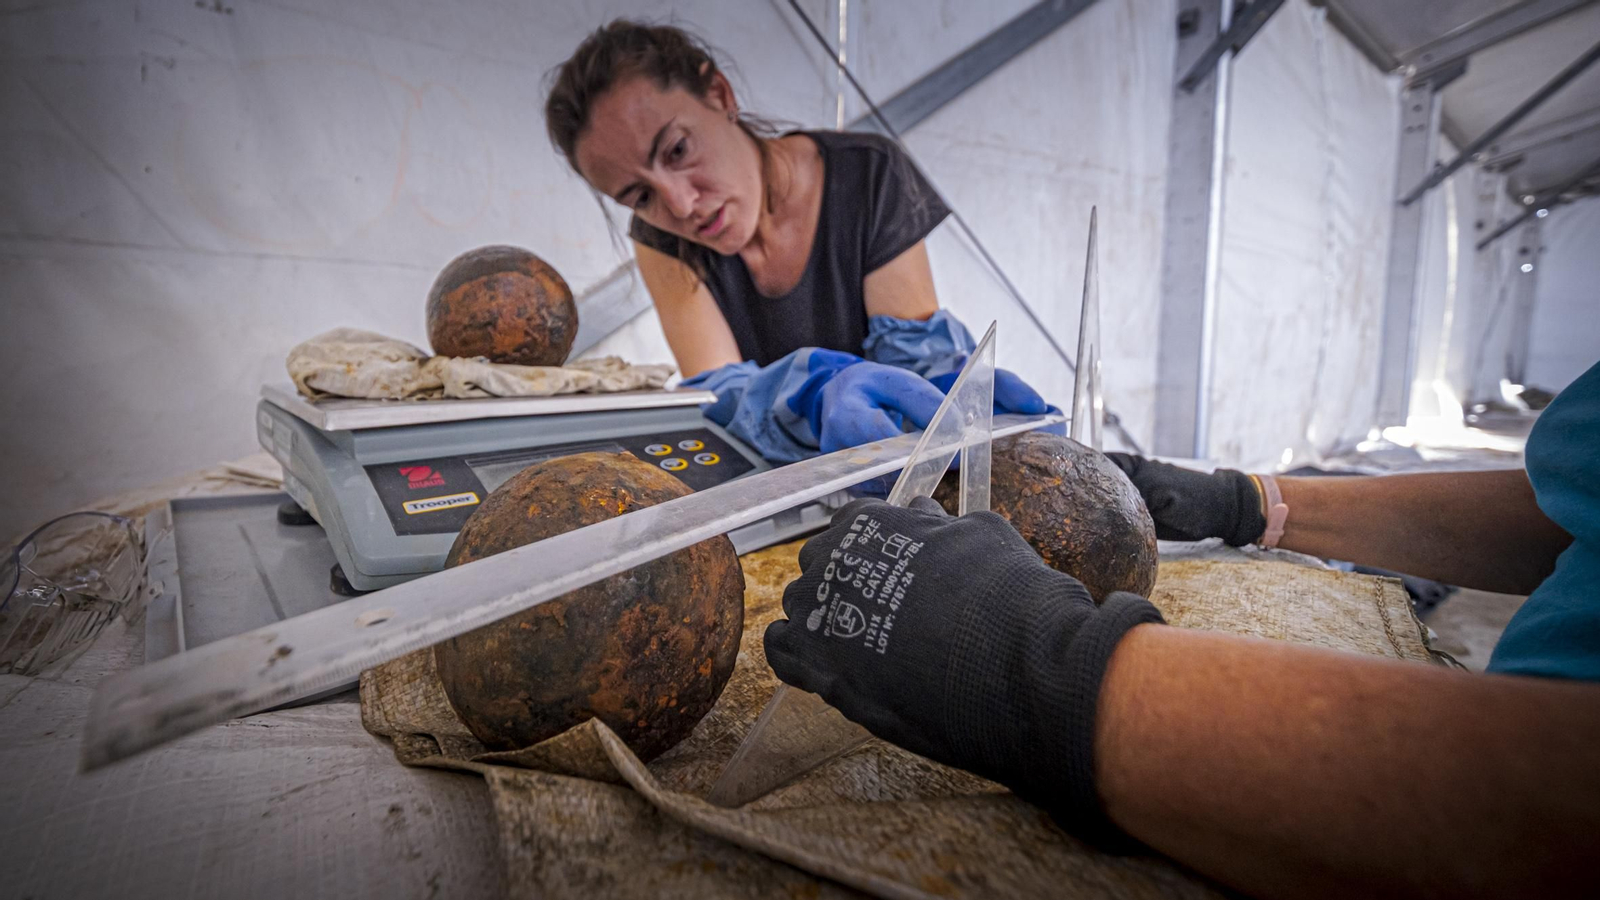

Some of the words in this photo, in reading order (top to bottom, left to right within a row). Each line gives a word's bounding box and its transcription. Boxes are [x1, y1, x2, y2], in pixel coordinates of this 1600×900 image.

[410, 496, 471, 510] Trooper
[858, 519, 881, 545] SIZE
[874, 532, 886, 543] 7
[816, 514, 869, 602] cofan
[864, 614, 882, 648] 1121X
[876, 632, 890, 655] LOT
